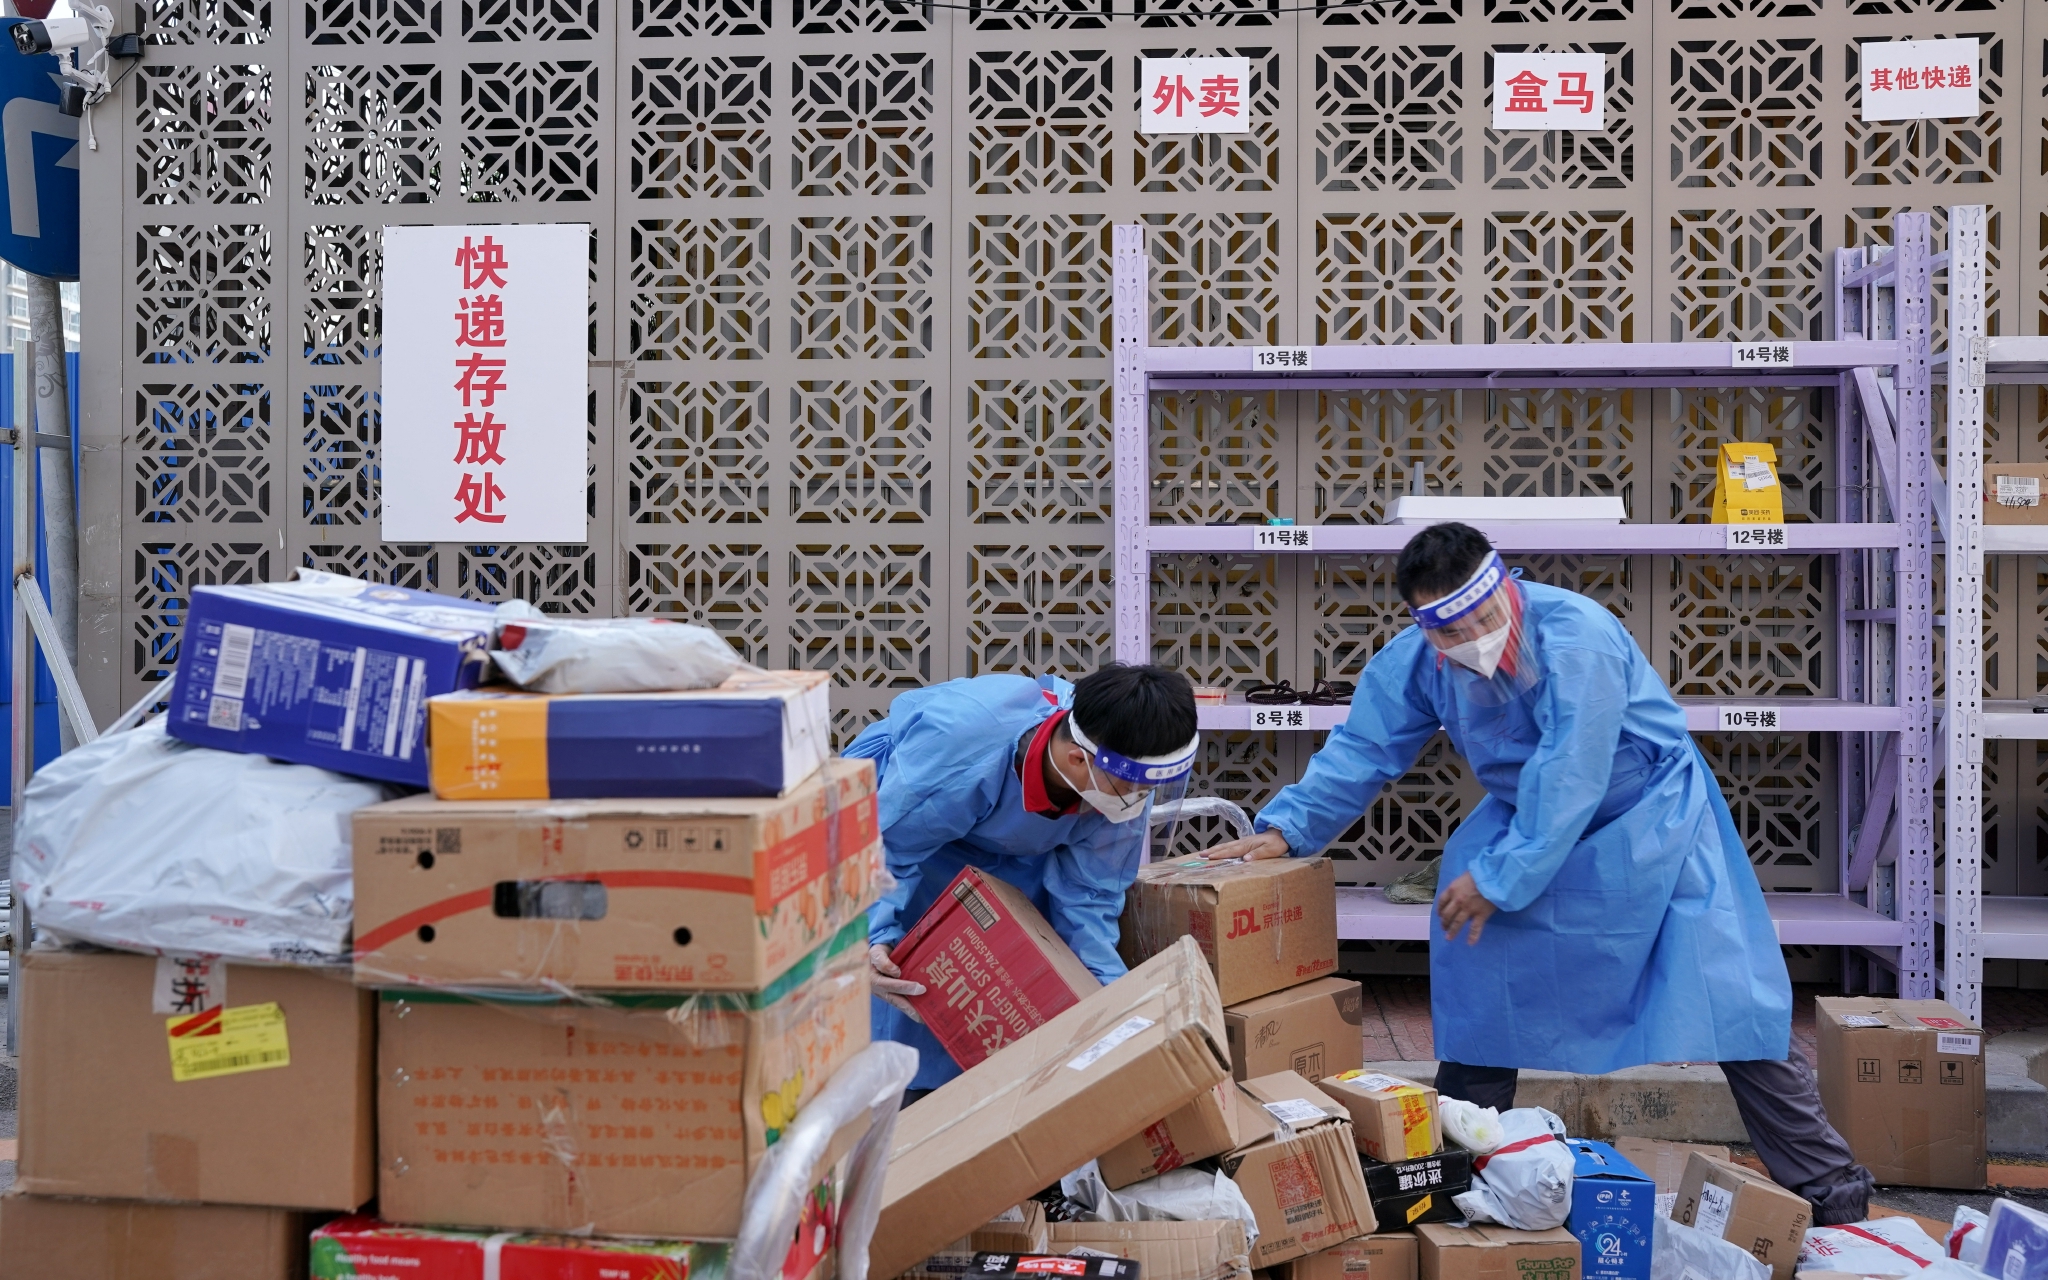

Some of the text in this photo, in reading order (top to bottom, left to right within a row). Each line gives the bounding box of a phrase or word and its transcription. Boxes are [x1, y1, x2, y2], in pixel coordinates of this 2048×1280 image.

[1871, 65, 1971, 92] 其他快递
[1154, 74, 1240, 117] 外卖
[1505, 70, 1594, 113] 盒马
[1259, 350, 1307, 367] 13号楼
[1738, 347, 1789, 363] 14号楼
[454, 236, 508, 524] 快递存放处
[1259, 530, 1308, 546] 11号楼
[1732, 529, 1784, 545] 12号楼
[1256, 711, 1303, 726] 8号楼
[1725, 711, 1776, 727] 10号楼
[1226, 907, 1261, 939] JDL
[1263, 905, 1303, 929] 京东快递
[949, 936, 991, 988] SPRING
[1398, 1169, 1442, 1191] 迷你罐
[1792, 1213, 1807, 1229] 1kg
[1752, 1236, 1774, 1258] 玛
